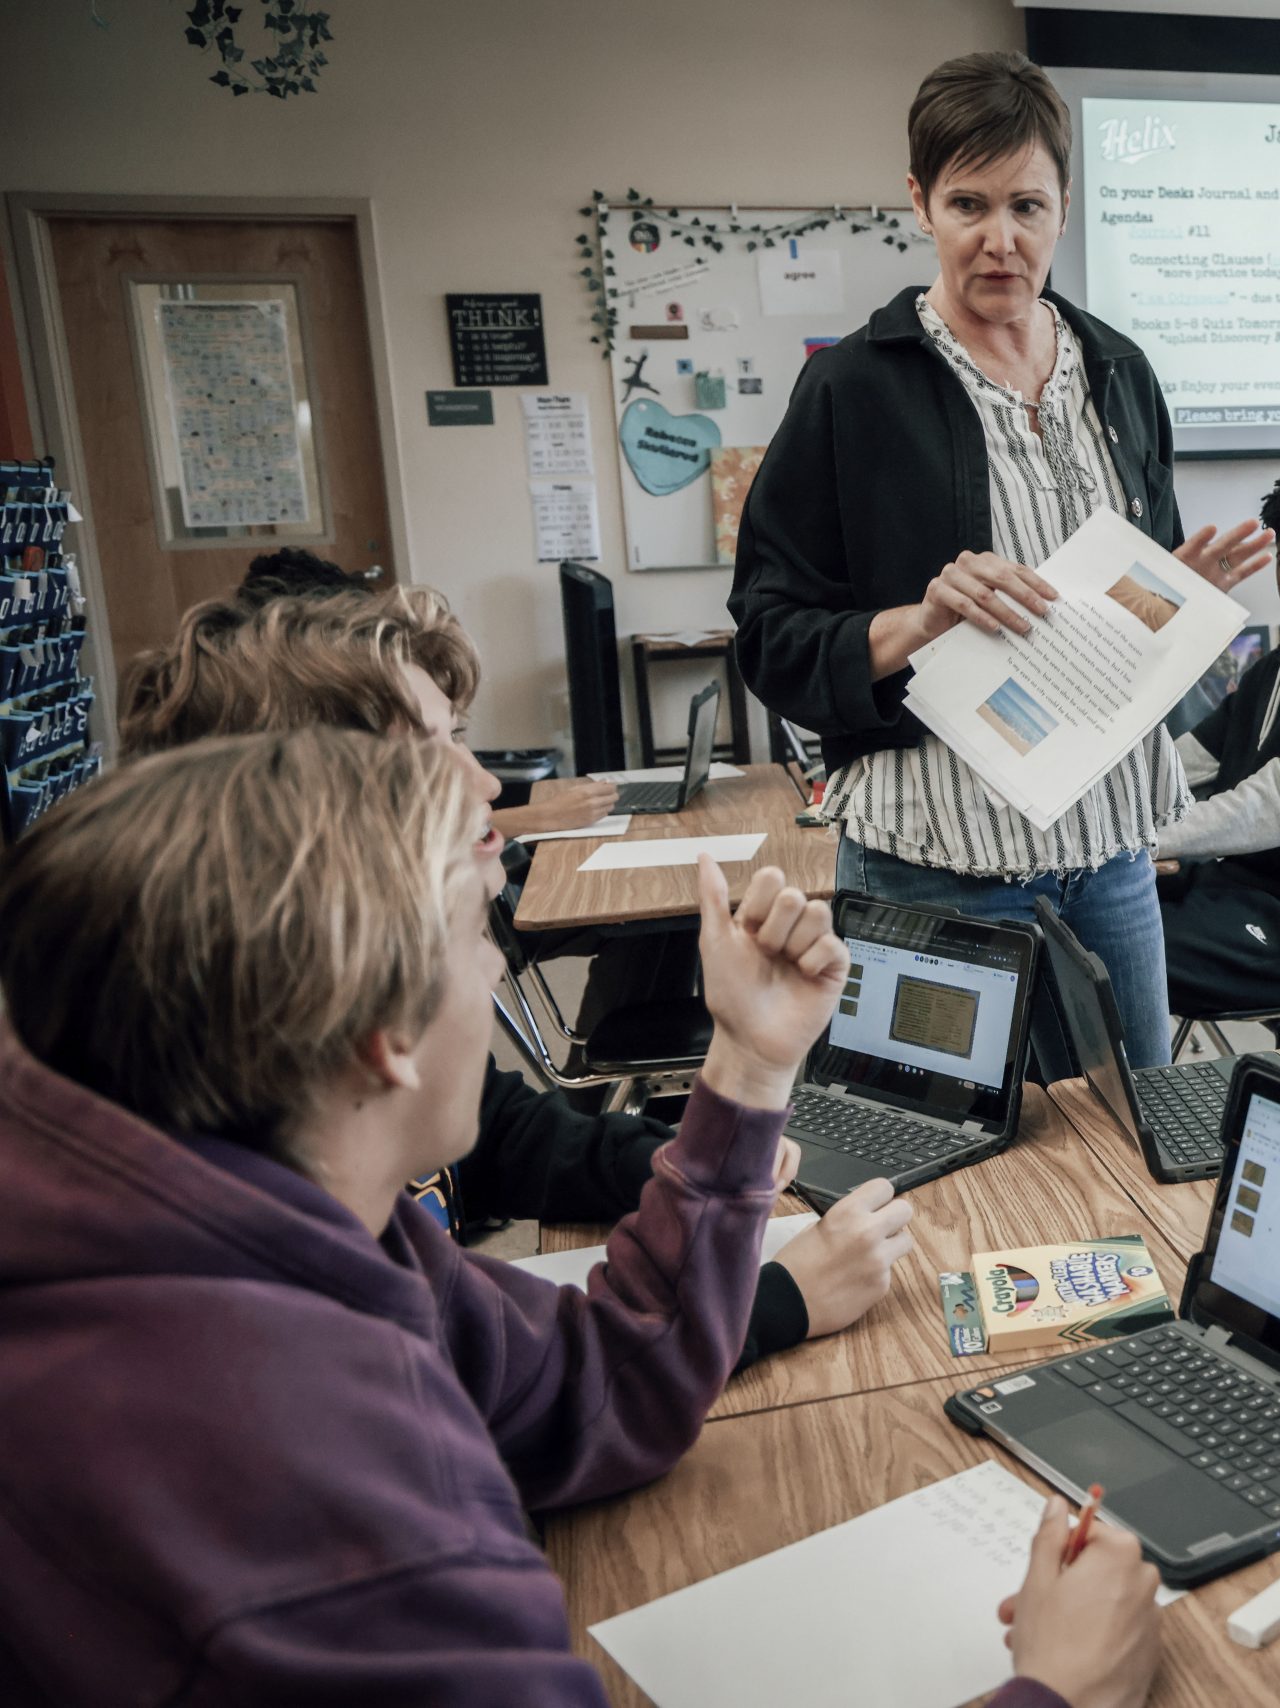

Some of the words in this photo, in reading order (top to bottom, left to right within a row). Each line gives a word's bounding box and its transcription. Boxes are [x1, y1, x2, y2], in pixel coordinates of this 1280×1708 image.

[1098, 116, 1177, 164] Helix
[1100, 186, 1118, 198] On
[1122, 189, 1154, 200] your
[1158, 187, 1194, 199] Desk:
[1198, 187, 1252, 199] Journal
[1256, 190, 1279, 200] and
[1101, 211, 1153, 225] Agenda:
[1188, 226, 1211, 237] #11
[1130, 253, 1208, 267] Connecting
[1212, 254, 1263, 265] Clauses
[1195, 268, 1248, 279] practice
[1251, 292, 1272, 303] due
[452, 308, 540, 327] THINK!
[1132, 319, 1170, 330] Books
[1202, 318, 1233, 331] Quiz
[1211, 332, 1271, 345] Discovery
[1181, 380, 1216, 392] Enjoy
[1221, 381, 1250, 393] your
[1178, 409, 1221, 421] Please
[1225, 408, 1264, 421] bring
[1067, 1252, 1105, 1307] WASHABLE
[1094, 1254, 1130, 1300] MARKERS
[985, 1268, 1015, 1314] Crayola
